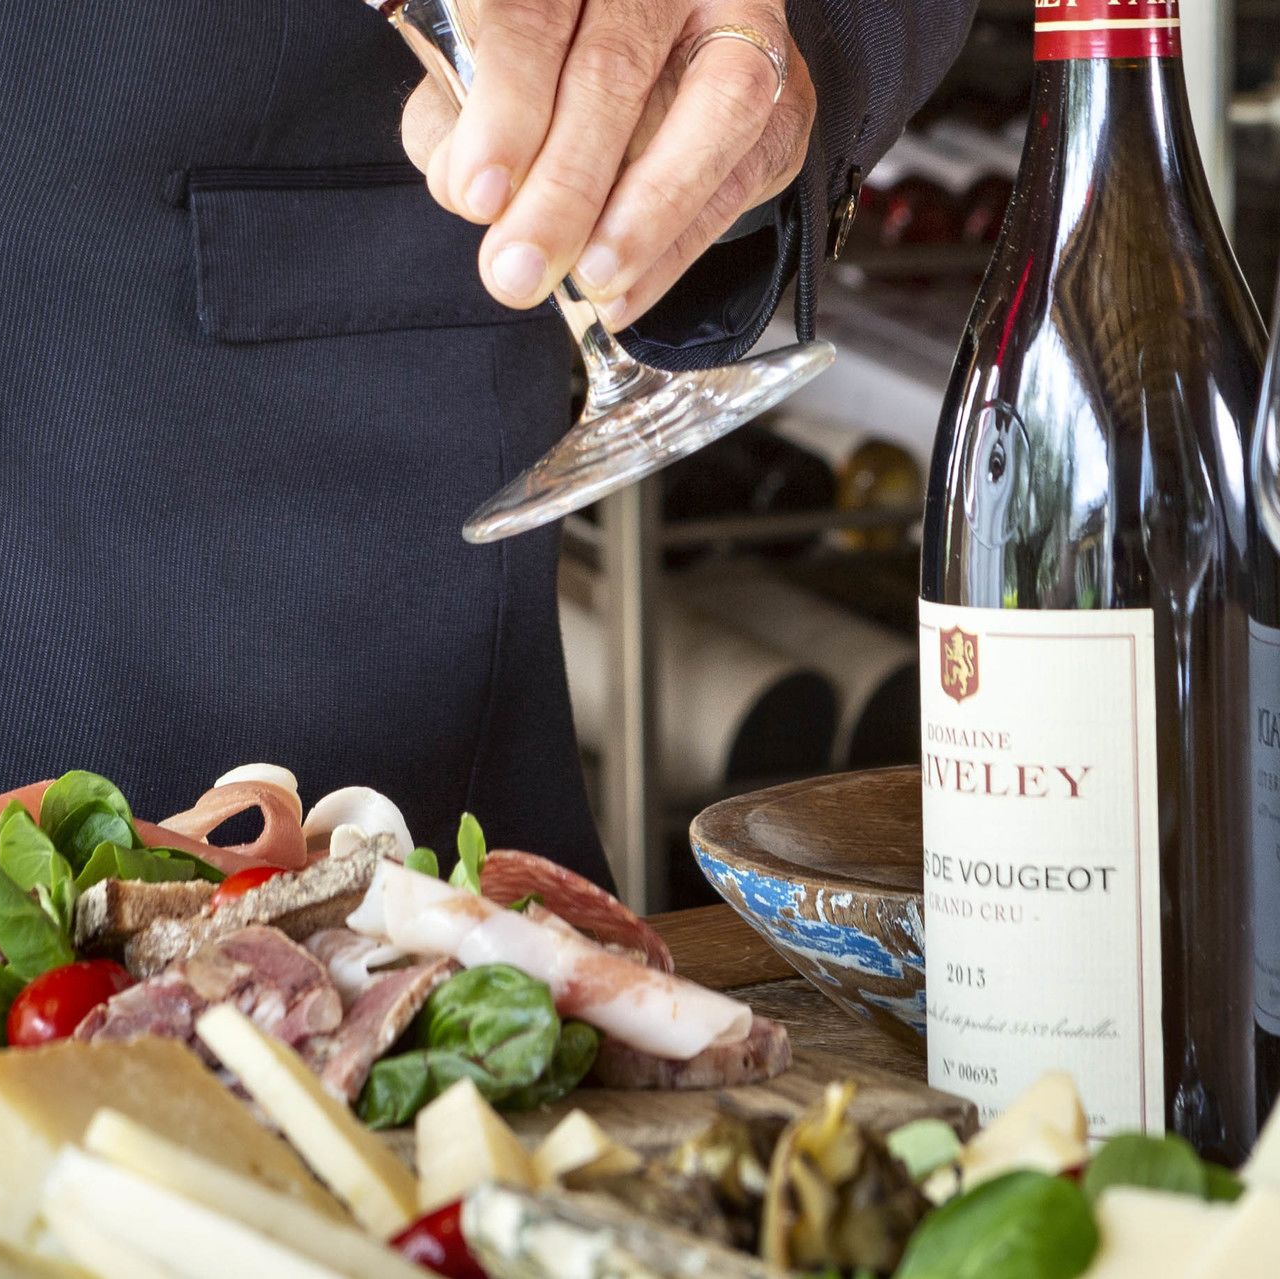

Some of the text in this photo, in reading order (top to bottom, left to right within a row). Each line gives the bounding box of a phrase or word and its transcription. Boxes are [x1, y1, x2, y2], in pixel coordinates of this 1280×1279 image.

[927, 721, 1012, 750] DOMAINE
[922, 752, 1092, 798] IVELEY
[932, 852, 953, 882] DE
[958, 860, 1116, 893] VOUGEOT
[928, 891, 1023, 924] GRAND CRU
